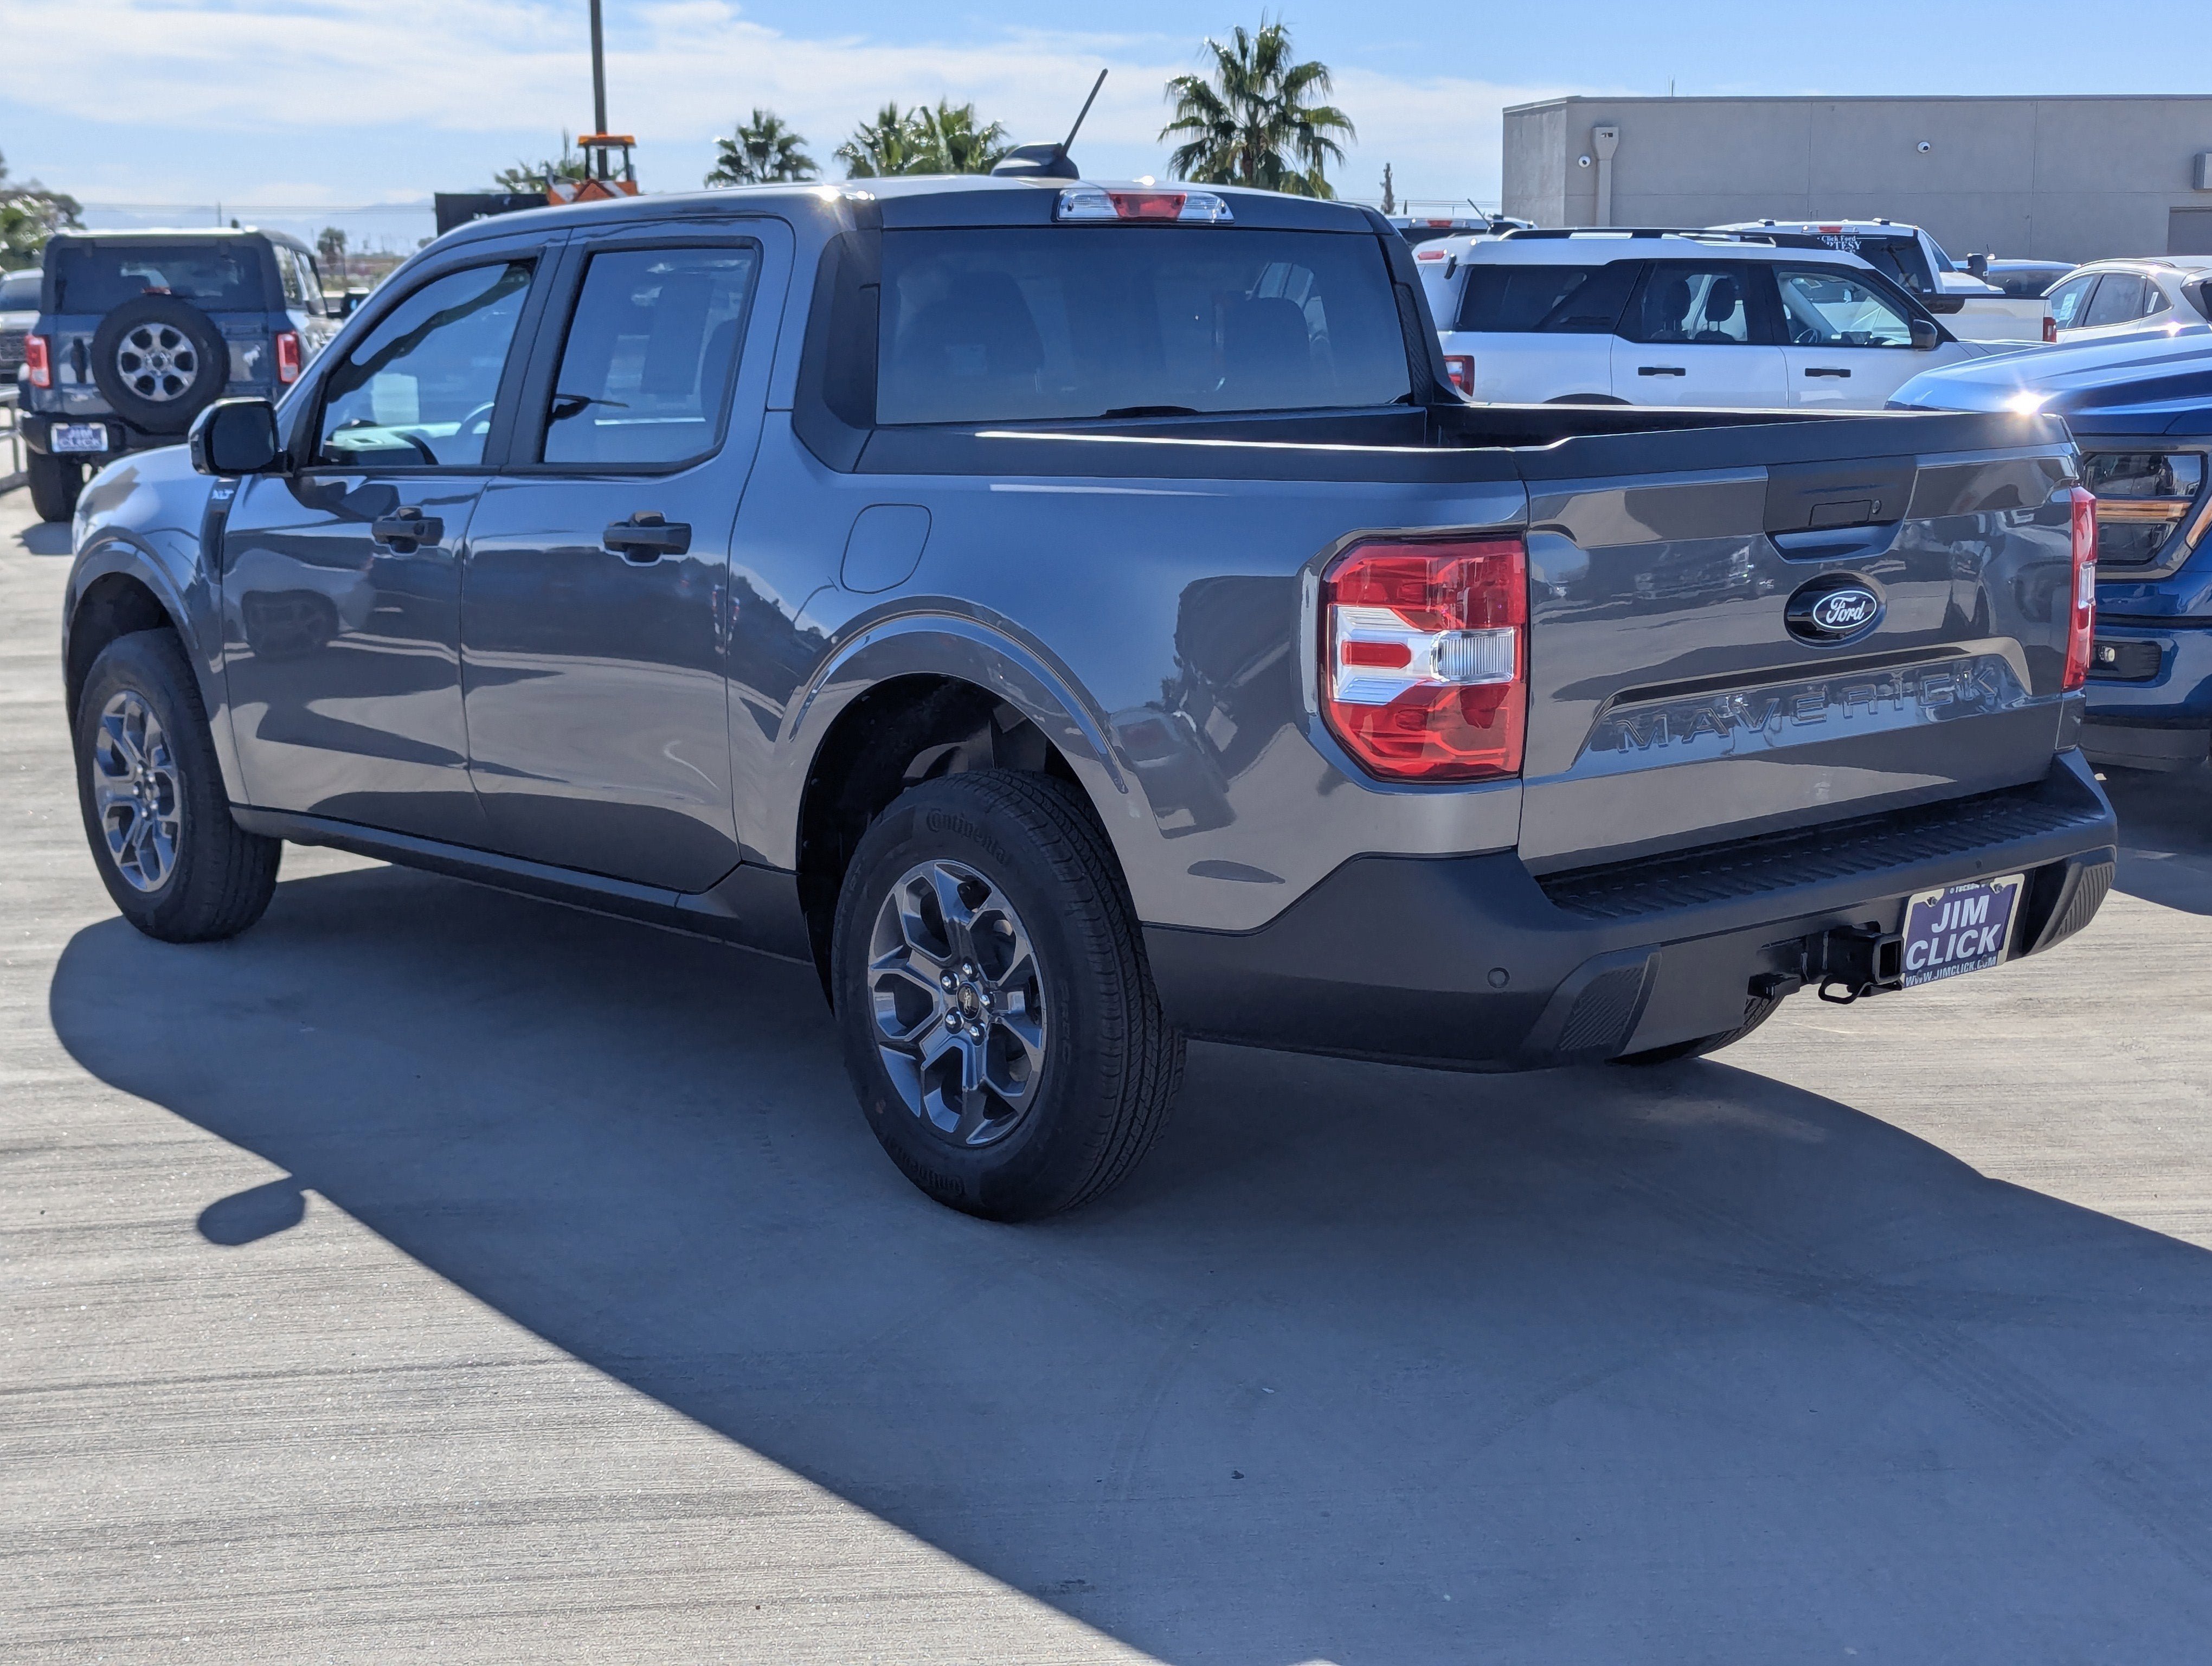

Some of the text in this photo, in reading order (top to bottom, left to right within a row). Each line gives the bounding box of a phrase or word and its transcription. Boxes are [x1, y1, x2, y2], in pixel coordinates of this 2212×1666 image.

[1825, 596, 1866, 624] Ford
[1616, 667, 1998, 754] MAVERICK
[1931, 895, 1990, 933] JIM
[1906, 924, 2002, 970] CLICK
